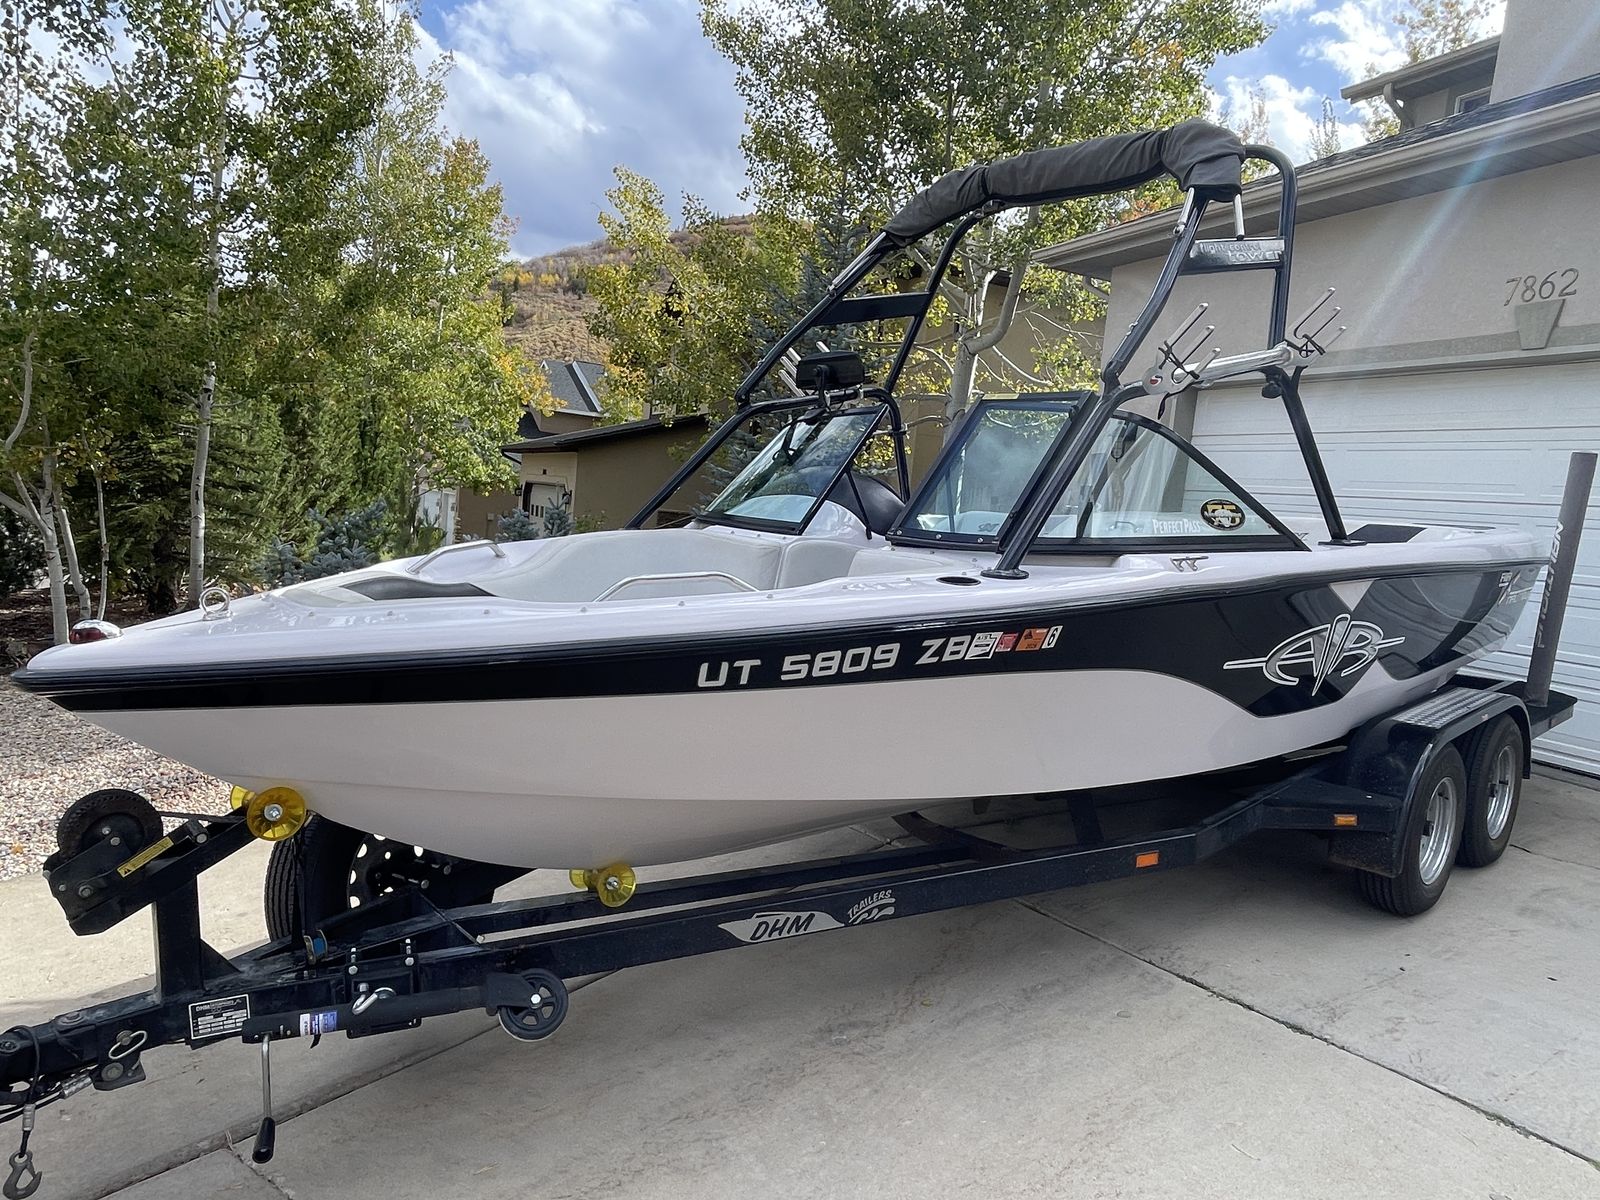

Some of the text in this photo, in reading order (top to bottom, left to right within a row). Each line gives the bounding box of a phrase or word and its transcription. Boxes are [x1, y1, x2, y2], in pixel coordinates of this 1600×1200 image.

[1503, 267, 1579, 307] 7862
[697, 659, 762, 688] UT
[780, 643, 900, 681] 5809
[914, 635, 973, 666] ZB
[847, 889, 893, 918] TRAILERS
[750, 912, 816, 941] DHM
